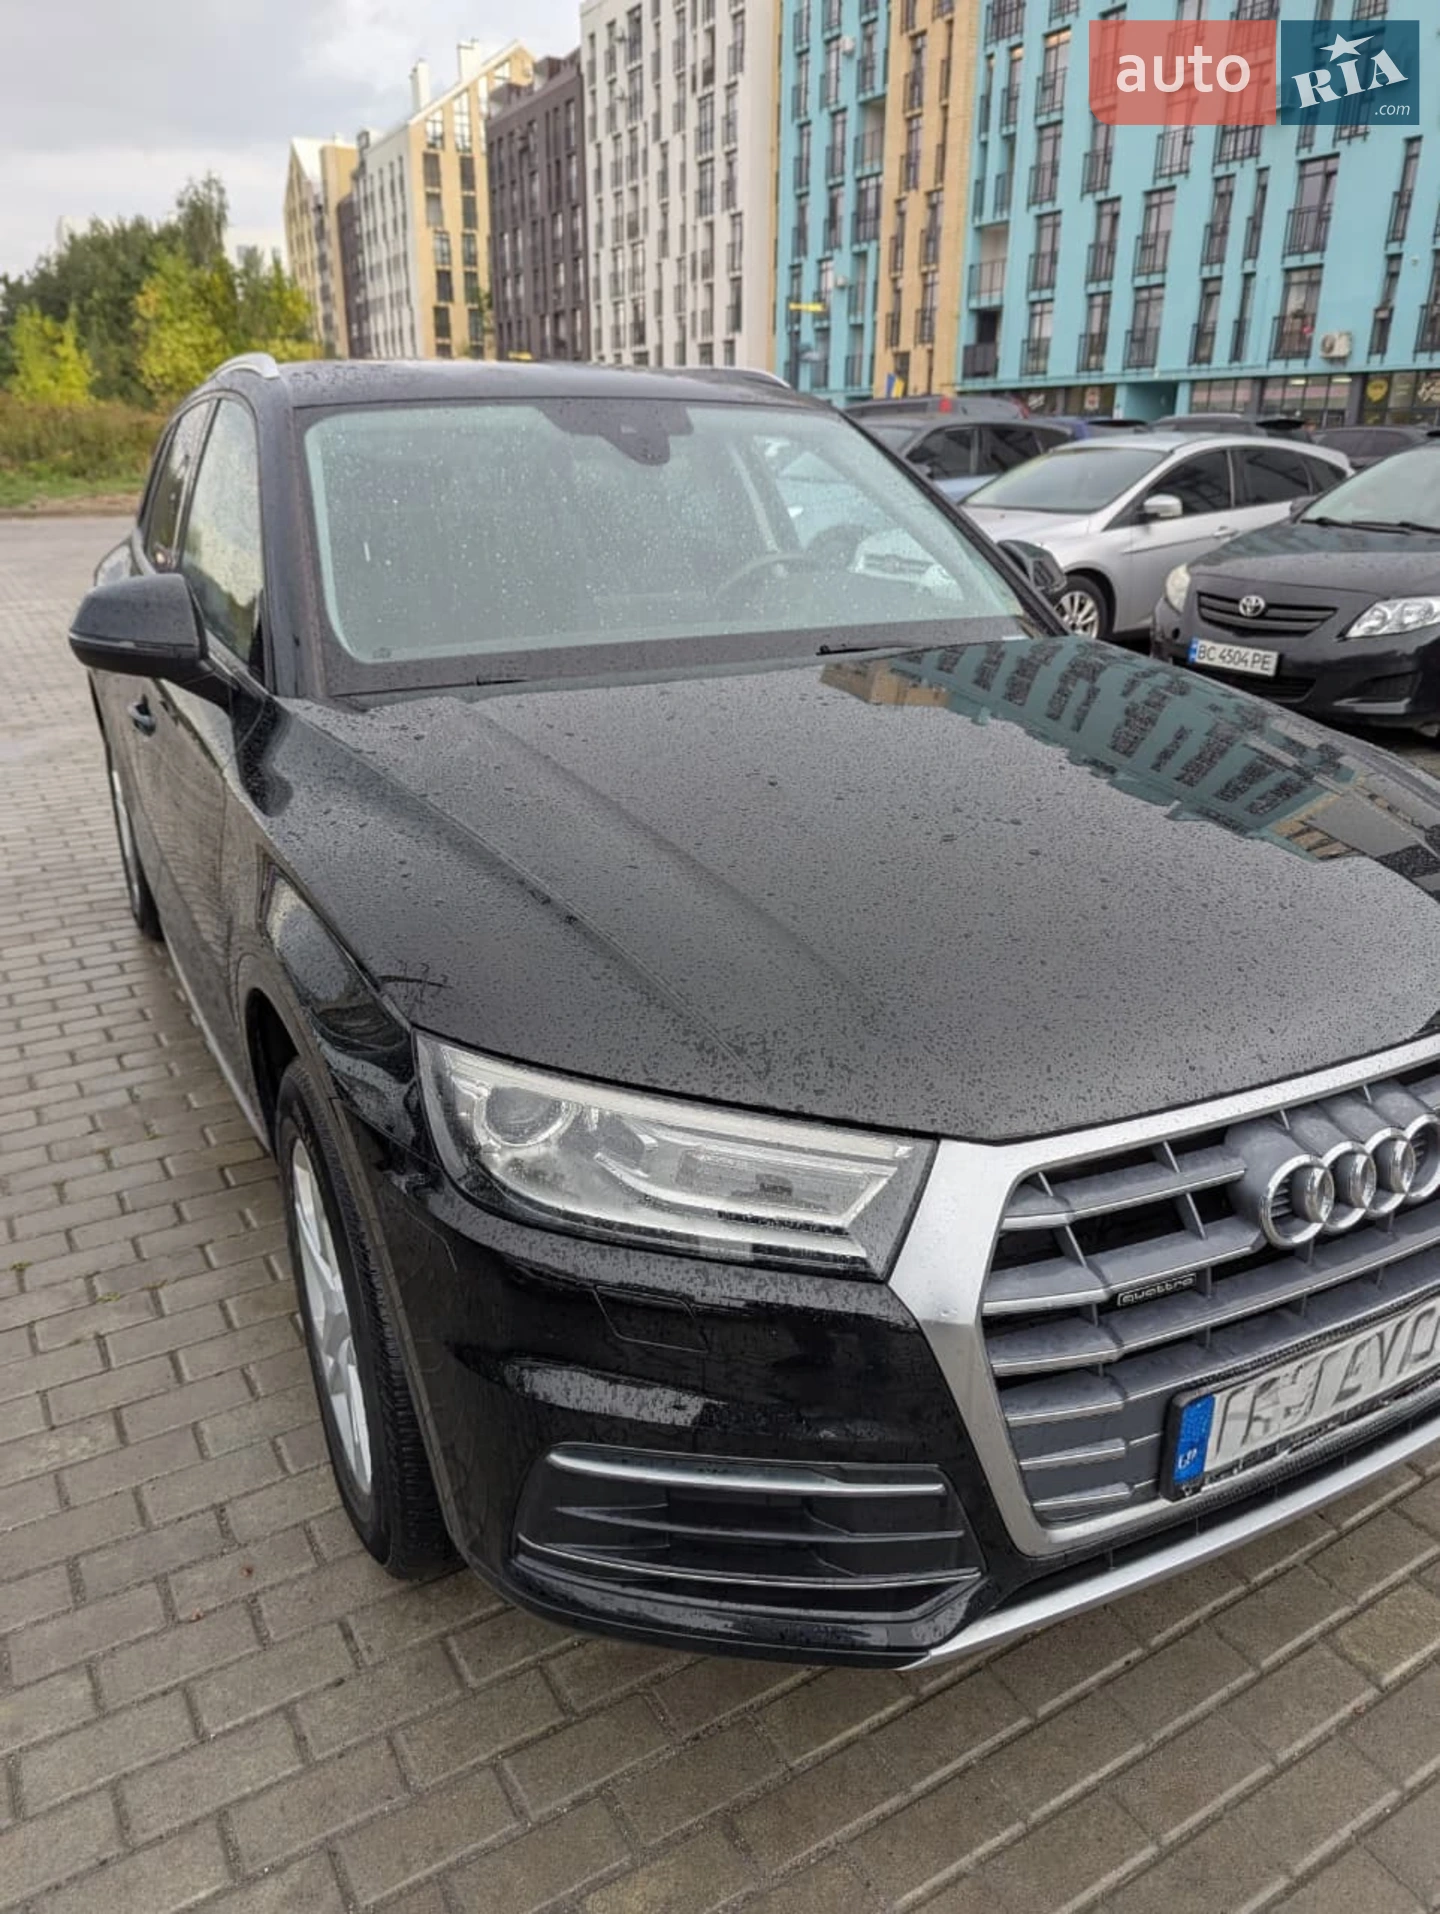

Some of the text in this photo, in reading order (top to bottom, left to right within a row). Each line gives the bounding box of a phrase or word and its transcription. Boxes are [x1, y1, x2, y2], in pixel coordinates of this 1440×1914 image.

[1198, 644, 1273, 671] BC 4504 PE
[1121, 1277, 1194, 1304] quattro
